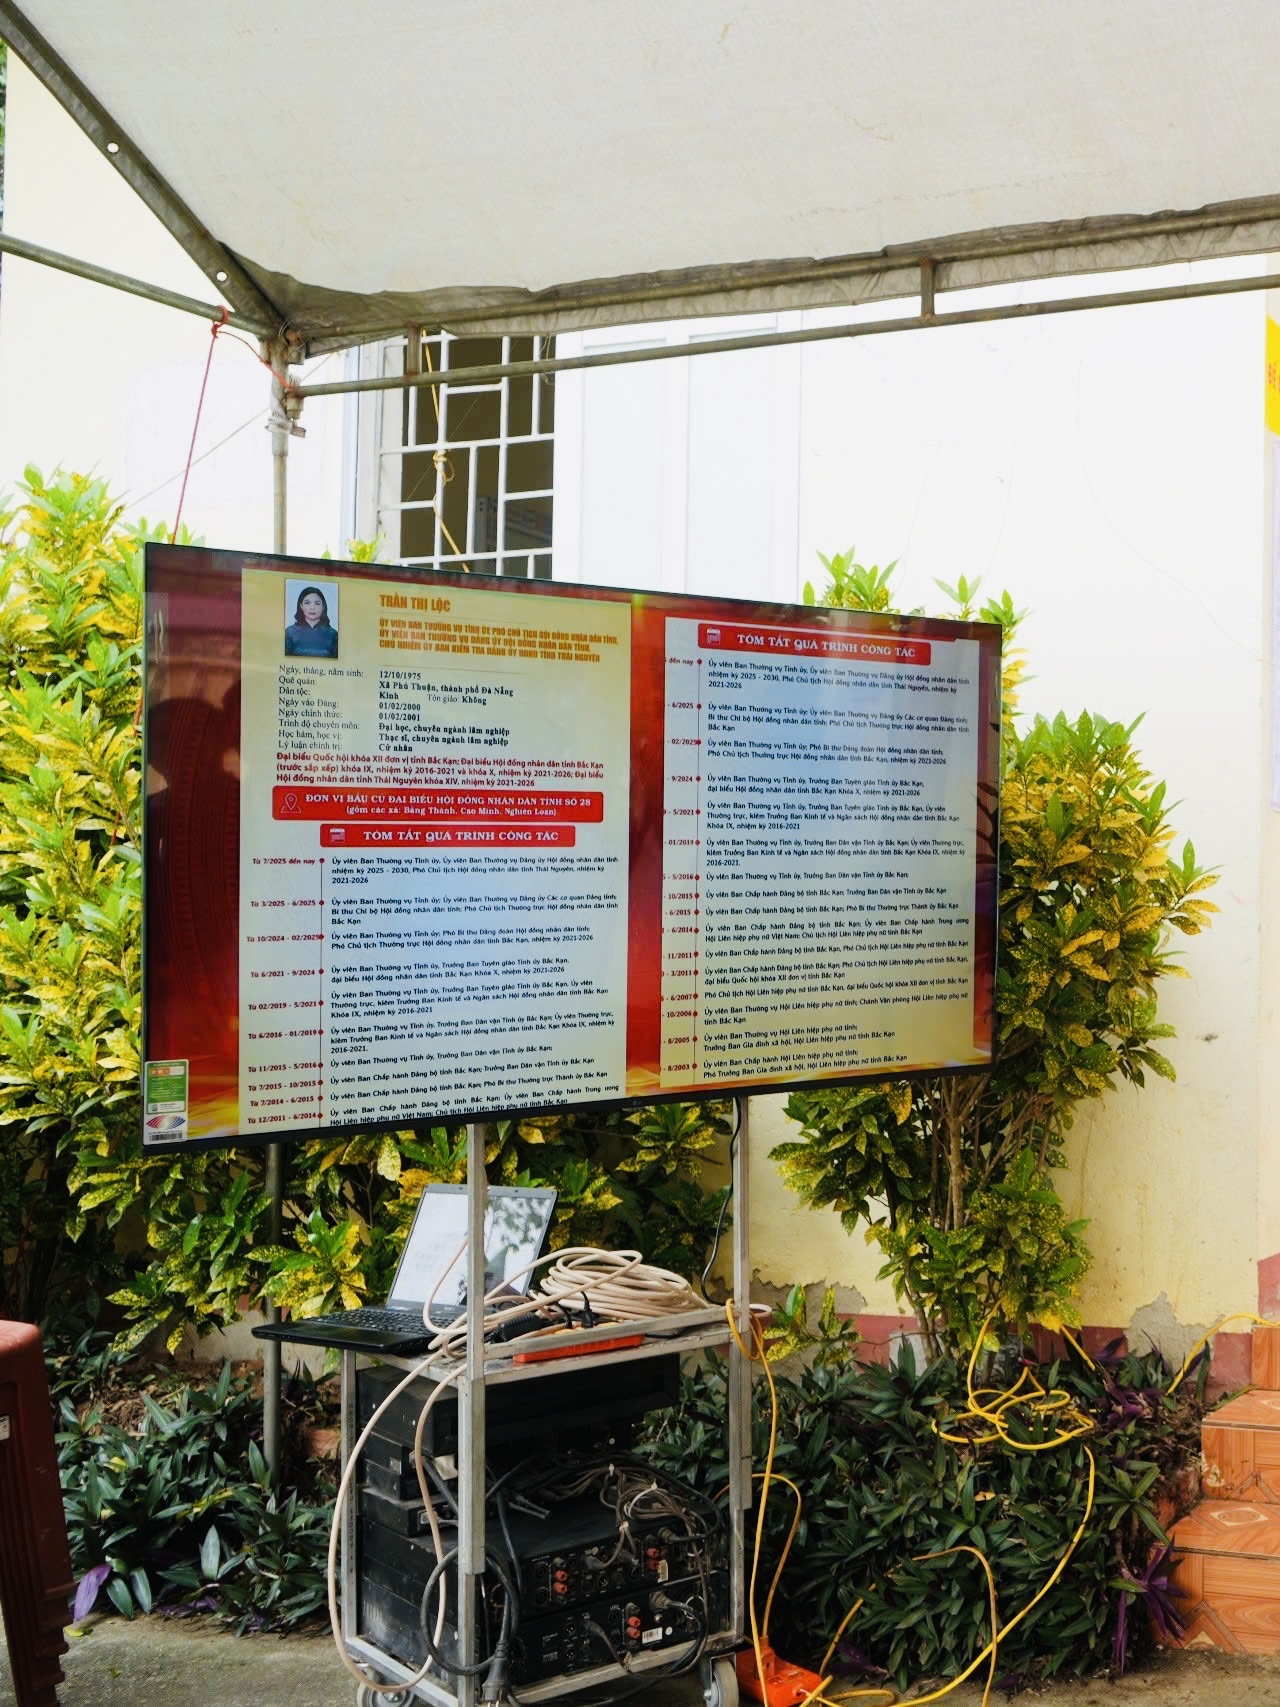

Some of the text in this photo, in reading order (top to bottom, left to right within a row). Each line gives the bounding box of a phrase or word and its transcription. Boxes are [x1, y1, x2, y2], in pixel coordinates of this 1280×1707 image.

[380, 593, 451, 614] TRẦN THỊ LỘC
[737, 633, 915, 658] TÓM TẮT QUÁ TRÌNH CÔNG TÁC
[380, 670, 421, 680] 12/10/1975
[279, 686, 311, 696] Dân tộc:
[379, 681, 390, 689] Xã
[393, 681, 409, 691] Phú
[412, 683, 439, 694] Thuận,
[441, 684, 463, 693] thành
[481, 686, 492, 694] Đà
[379, 691, 399, 700] Kinh
[378, 702, 421, 711] 01/02/2000
[378, 712, 420, 721] 01/02/2001
[379, 722, 510, 739] Đại học, chuyên ngành lâm nghiệp
[276, 752, 291, 762] Đại
[292, 751, 311, 761] biểu
[312, 753, 334, 762] Quốc
[336, 754, 349, 763] hội
[350, 754, 371, 763] khóa
[384, 755, 400, 763] đơn
[401, 756, 409, 765] vị
[410, 756, 426, 764] tỉnh
[427, 756, 441, 765] Bắc
[460, 757, 474, 766] Đại
[475, 757, 492, 766] biểu
[492, 758, 506, 767] Hội
[506, 758, 526, 768] đồng
[546, 760, 560, 768] dân
[561, 760, 576, 768] tỉnh
[576, 760, 589, 769] Bắc
[363, 829, 558, 843] TÓM TẮT QUÁ TRÌNH CÔNG TÁC
